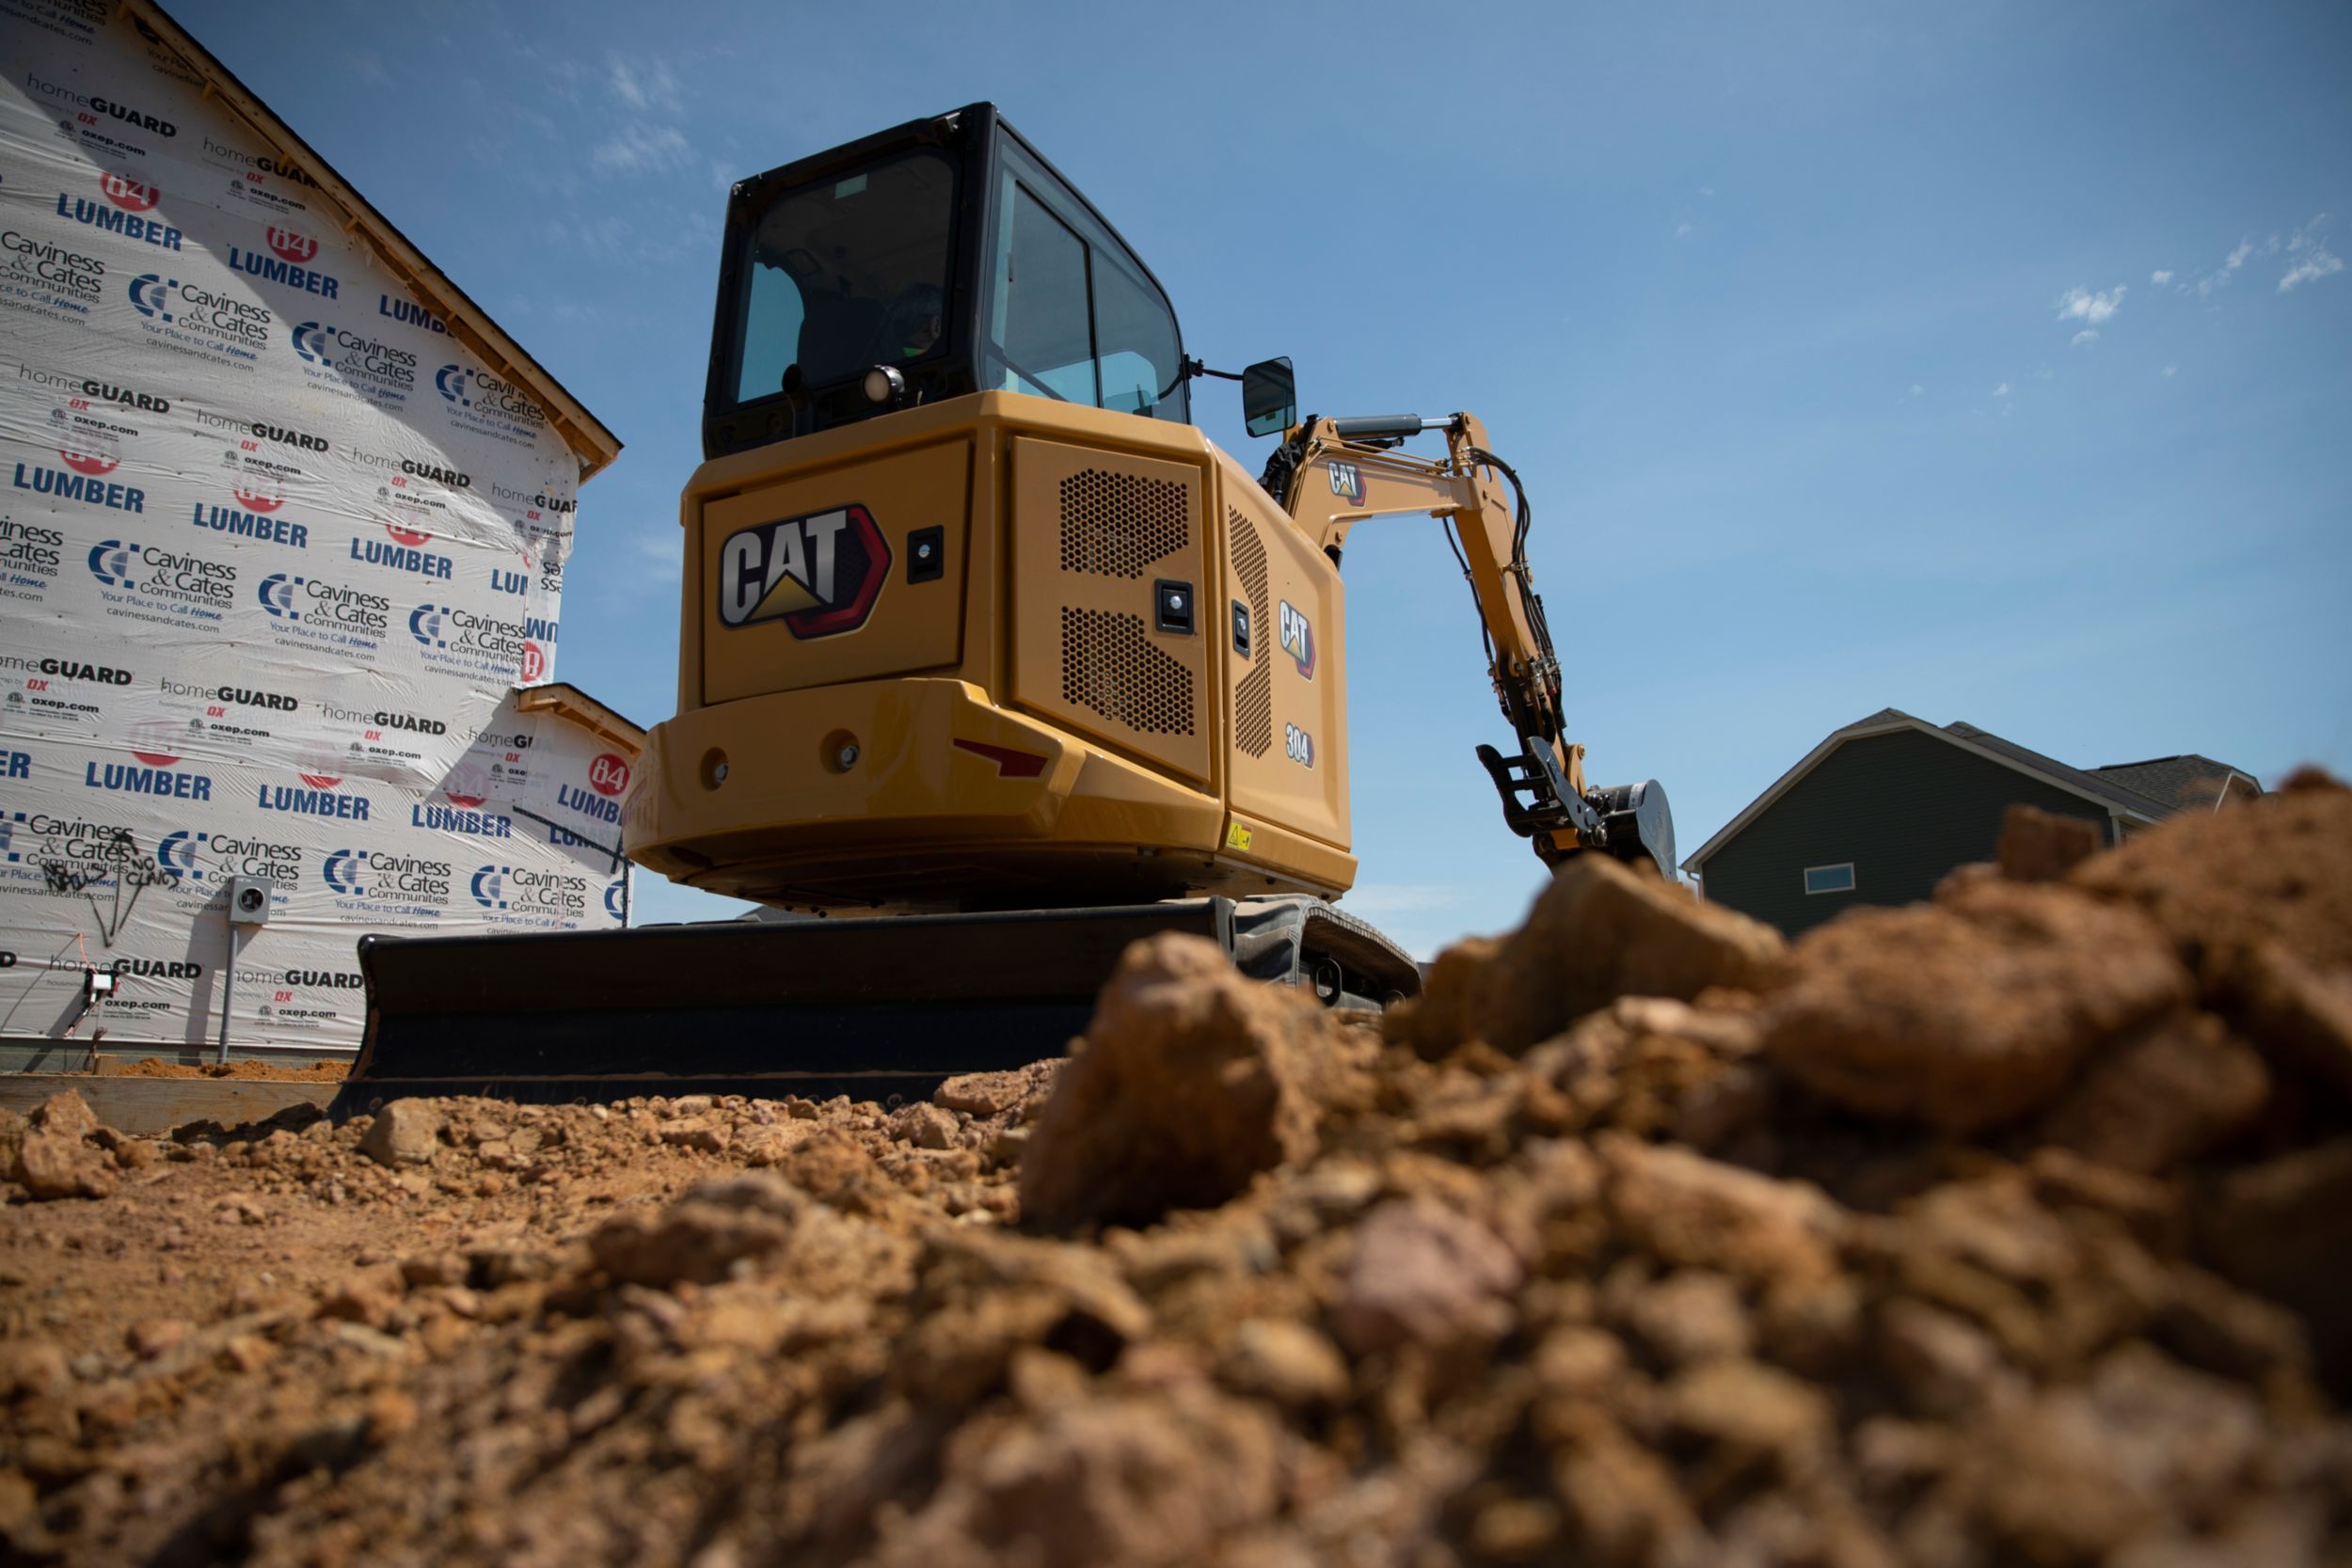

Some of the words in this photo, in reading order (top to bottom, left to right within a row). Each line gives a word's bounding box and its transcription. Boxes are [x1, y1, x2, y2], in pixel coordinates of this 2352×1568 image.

[26, 71, 179, 138] homeGUARD
[56, 192, 183, 252] LUMBER
[1, 230, 105, 275] Caviness
[11, 254, 34, 273] &
[37, 260, 103, 293] Cates
[229, 246, 340, 300] LUMBER
[31, 291, 51, 304] Call
[54, 297, 90, 315] Home
[181, 284, 271, 324] Caviness
[178, 316, 267, 350] Communities
[189, 305, 209, 324] &
[212, 310, 268, 341] Cates
[140, 321, 162, 334] Your
[165, 327, 191, 342] Place
[194, 336, 204, 346] to
[206, 340, 224, 352] Call
[226, 345, 259, 361] Home
[337, 330, 417, 367] Caviness
[335, 361, 414, 391] Communities
[345, 349, 363, 367] &
[364, 355, 415, 383] Cates
[19, 363, 171, 414] homeGUARD
[483, 391, 499, 406] &
[501, 395, 545, 420] Cates
[197, 408, 329, 452] homeGUARD
[473, 400, 545, 430] Communities
[353, 447, 471, 488] homeGUARD
[1328, 461, 1357, 498] CAT
[13, 462, 146, 514] LUMBER
[193, 501, 309, 548] LUMBER
[142, 546, 237, 580] Caviness
[350, 537, 453, 580] LUMBER
[723, 509, 847, 624] CAT
[9, 573, 47, 589] Home
[140, 582, 232, 610] Communities
[151, 568, 172, 587] &
[175, 572, 234, 599] Cates
[306, 579, 389, 611] Caviness
[101, 590, 124, 603] Your
[127, 594, 154, 609] Place
[156, 601, 167, 611] to
[170, 603, 188, 615] Call
[190, 607, 224, 621] Home
[314, 600, 333, 617] &
[335, 603, 388, 628] Cates
[304, 612, 386, 639] Communities
[452, 610, 527, 639] Caviness
[1279, 600, 1308, 662] CAT
[450, 641, 524, 665] Communities
[459, 629, 476, 645] &
[478, 631, 525, 656] Cates
[160, 676, 298, 712] homeGUARD
[323, 702, 446, 736] homeGUARD
[1286, 722, 1309, 765] 304
[85, 760, 212, 801] LUMBER
[592, 758, 626, 791] 84
[258, 783, 370, 821] LUMBER
[557, 783, 623, 826] LUMB
[29, 814, 134, 842] Caviness
[411, 803, 512, 838] LUMBER
[40, 837, 61, 855] &
[65, 838, 130, 863] Cates
[211, 834, 302, 861] Caviness
[370, 852, 452, 877] Caviness
[11, 869, 41, 881] Place
[219, 856, 240, 873] &
[242, 857, 299, 880] Cates
[377, 873, 395, 889] &
[398, 873, 450, 895] Cates
[512, 867, 586, 891] Caviness
[368, 886, 449, 905] Communities
[520, 886, 536, 903] &
[538, 888, 585, 909] Cates
[104, 999, 170, 1009] oxep.com
